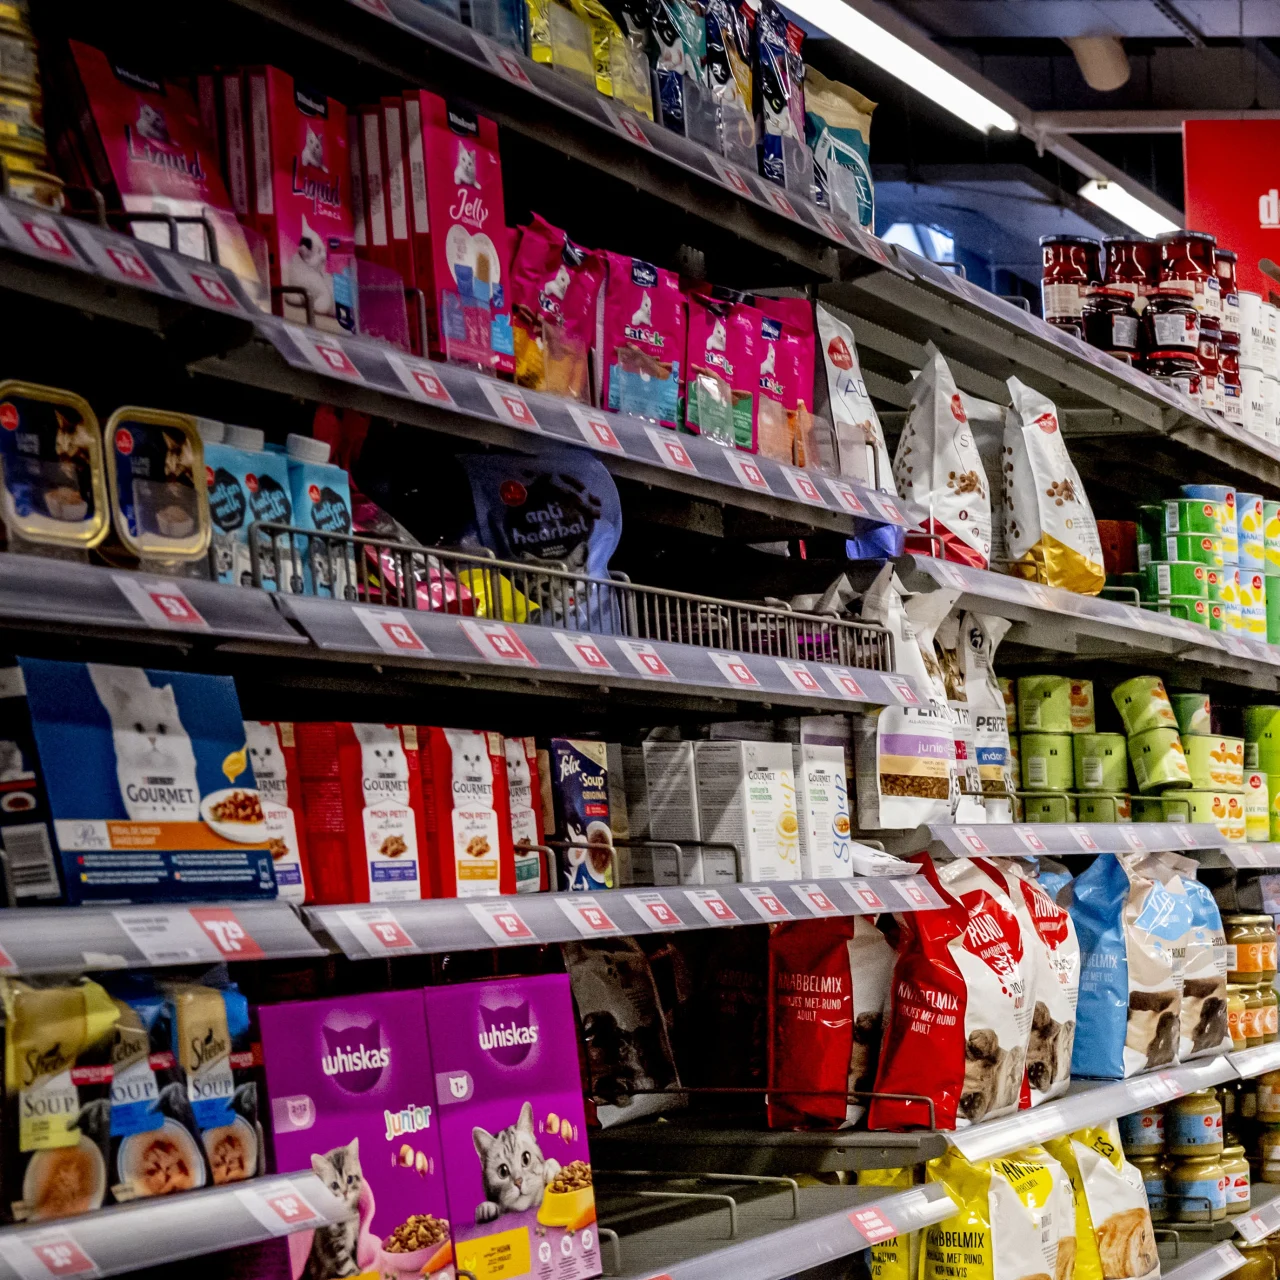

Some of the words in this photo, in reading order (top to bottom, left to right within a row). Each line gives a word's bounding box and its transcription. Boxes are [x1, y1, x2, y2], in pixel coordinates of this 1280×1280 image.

[449, 188, 489, 229] Jelly
[525, 502, 563, 524] anti
[560, 755, 581, 782] felix
[749, 771, 775, 782] GOURMET
[363, 778, 410, 793] GOURMET
[808, 773, 832, 783] GOURMET
[126, 783, 195, 805] GOURMET
[453, 780, 493, 796] GOURMET
[388, 810, 408, 819] PETIT
[967, 913, 1004, 948] RUND
[777, 972, 842, 993] KNABBELMIX
[822, 997, 842, 1010] RUND
[797, 1010, 817, 1021] ADULT
[937, 1013, 957, 1026] RUND
[479, 1022, 538, 1051] whiskas
[911, 1022, 931, 1035] ADULT
[322, 1044, 391, 1077] whiskas
[192, 1079, 232, 1099] SOUP
[23, 1096, 76, 1118] SOUP
[383, 1103, 432, 1142] Junior
[947, 1253, 962, 1264] MET
[963, 1252, 984, 1266] RUND,
[956, 1266, 968, 1278] VIS
